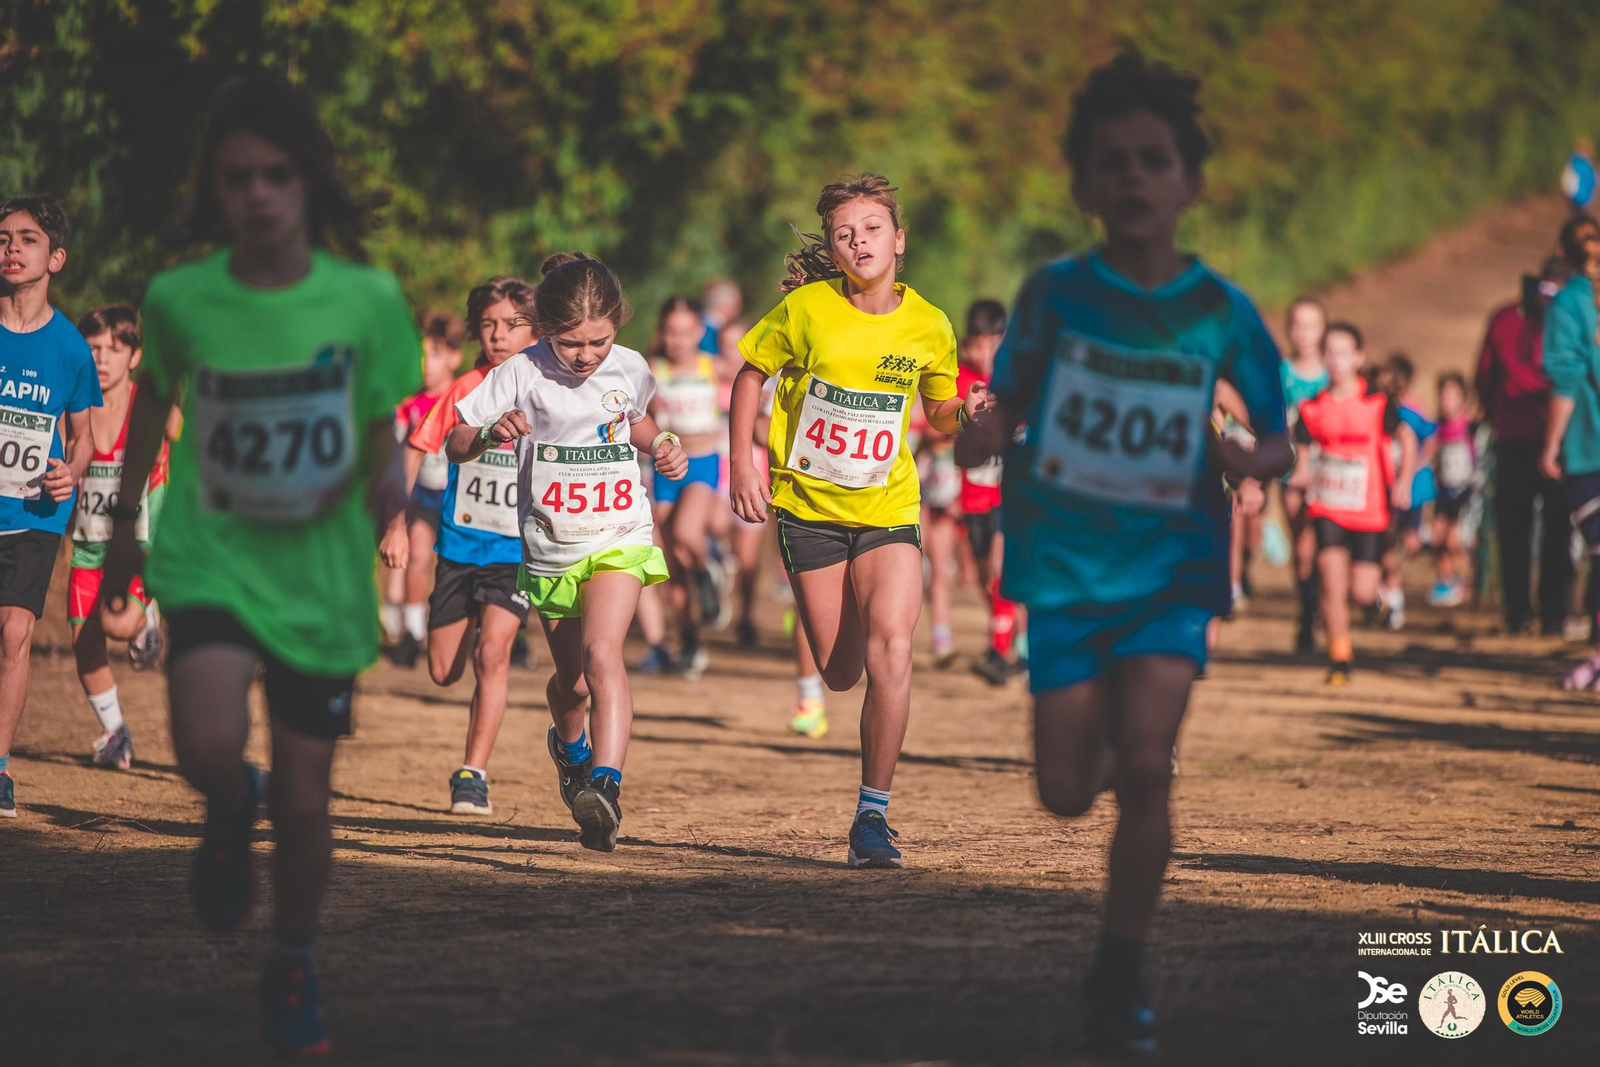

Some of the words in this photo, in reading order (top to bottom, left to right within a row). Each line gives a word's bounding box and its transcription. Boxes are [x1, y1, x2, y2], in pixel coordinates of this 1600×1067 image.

[832, 391, 879, 408] ITÁLICA
[805, 418, 894, 461] 4510
[1056, 391, 1190, 460] 4204
[206, 416, 344, 475] 4270
[565, 448, 614, 461] ITÁLICA
[541, 479, 633, 514] 4518
